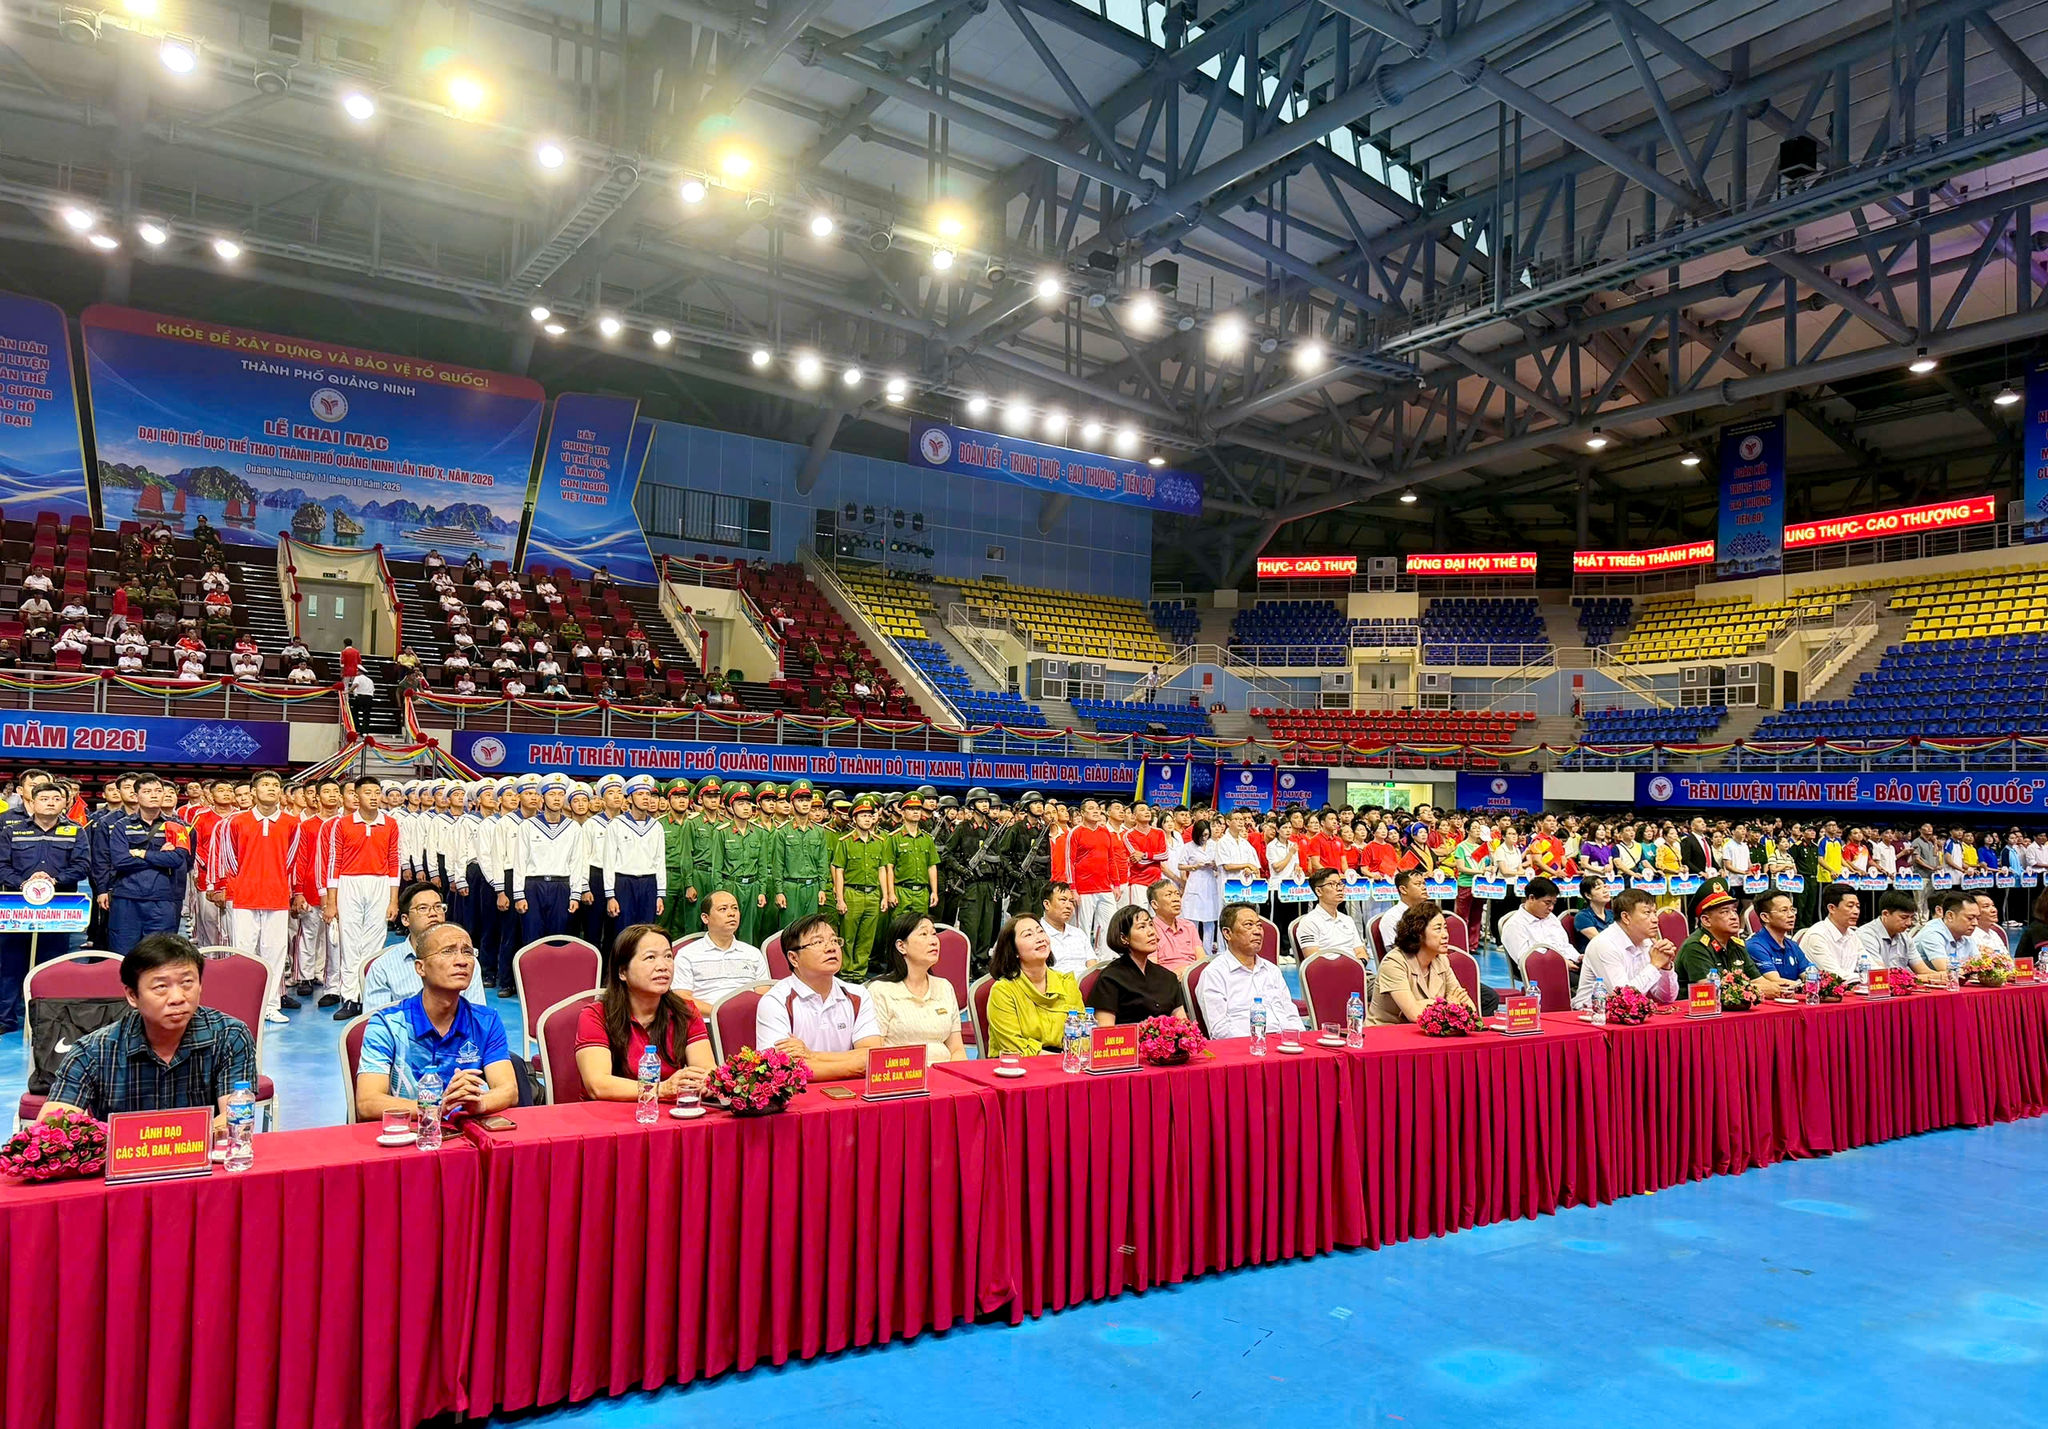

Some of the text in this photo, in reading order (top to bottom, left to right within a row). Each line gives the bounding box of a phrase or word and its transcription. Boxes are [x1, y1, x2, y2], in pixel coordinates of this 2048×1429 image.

[19, 341, 47, 354] DÂN
[156, 323, 489, 387] KHỎE ĐỂ XÂY DỰNG VÀ BẢO VỆ TỔ QUỐC!
[8, 354, 49, 371] LUYỆN
[241, 360, 416, 397] THÀNH PHỐ QUẢNG NINH
[8, 384, 52, 400] GƯƠNG
[4, 415, 31, 427] ĐẠI!
[264, 418, 389, 451] LỄ KHAI MẠC
[138, 425, 159, 443] ĐẠI
[160, 428, 179, 447] HỘI
[181, 430, 203, 447] THỂ
[203, 436, 225, 453] DỤC
[228, 437, 249, 454] THỂ
[249, 442, 275, 457] THAO
[278, 445, 311, 462] THÀNH
[313, 449, 335, 464] PHỐ
[336, 452, 369, 469] QUẢNG
[371, 459, 395, 473] NINH
[396, 459, 415, 476] LẦN
[418, 464, 436, 479] THỨ
[448, 468, 470, 483] NĂM
[471, 473, 493, 487] 2026
[245, 463, 272, 477] Quảng
[959, 440, 1156, 500] ĐOÀN KẾT TRUNG THỰC CAO THƯỢNG TIẾN BỘ!
[560, 478, 579, 489] CON
[1866, 515, 1899, 531] CAO
[1901, 505, 1970, 525] THƯỢNG
[1443, 558, 1465, 572] ĐẠI
[1468, 556, 1490, 571] HỘI
[1647, 549, 1686, 565] THÀNH
[3, 720, 148, 751] NĂM 2026!
[529, 742, 574, 765] PHÁT
[578, 740, 625, 766] TRIỂN
[629, 745, 681, 769] THÀNH
[684, 744, 718, 770] PHỐ
[719, 747, 770, 773] QUẢNG
[771, 752, 807, 773] NINH
[810, 751, 837, 774] TRỞ
[840, 753, 883, 775] THÀNH
[885, 754, 902, 776] ĐÔ
[906, 758, 926, 780] THỊ
[928, 760, 965, 780] XANH,
[968, 759, 993, 779] VĂN
[994, 761, 1029, 782] MINH,
[1031, 761, 1057, 783] HIỆN
[1059, 764, 1082, 785] ĐẠI,
[1084, 762, 1109, 783] GIÀU
[1111, 761, 1134, 783] BẢN
[1723, 780, 1773, 804] LUYỆN
[1775, 779, 1820, 801] THÂN
[1825, 777, 1858, 802] THỂ
[1875, 778, 1913, 803] BẢO
[1917, 780, 1941, 806] VỆ
[1948, 777, 1972, 803] TỔ
[12, 906, 83, 920] NHÂN NGÀNH THAN
[140, 1125, 182, 1140] LÃNH ĐẠO
[115, 1140, 204, 1160] CÁC SỞ, BAN, NGÀNH
